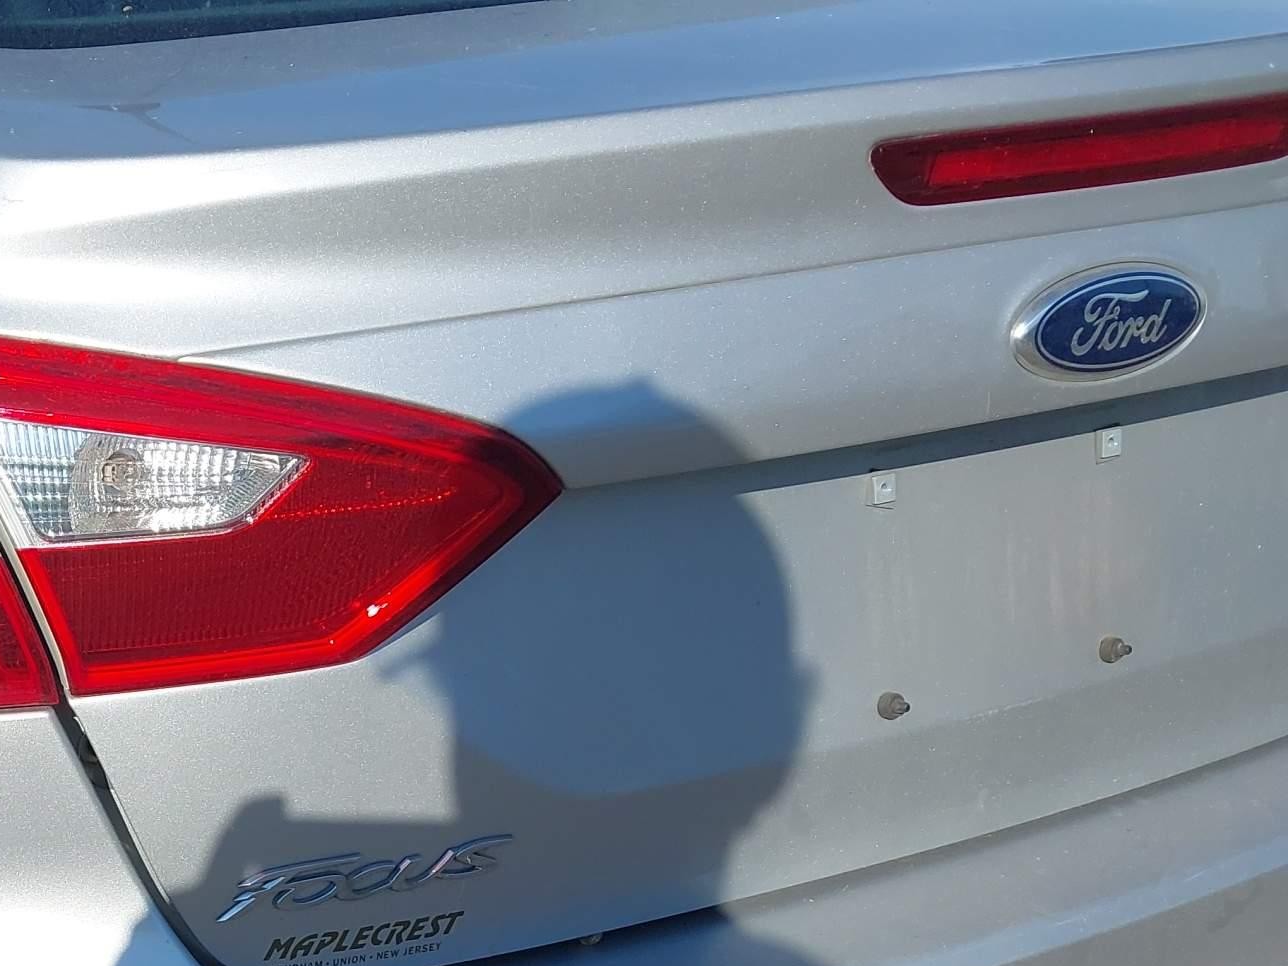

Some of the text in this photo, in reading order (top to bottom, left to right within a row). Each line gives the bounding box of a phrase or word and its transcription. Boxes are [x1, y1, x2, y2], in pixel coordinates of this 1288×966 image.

[1070, 289, 1172, 356] Ford
[264, 911, 464, 961] MAPLECREST
[376, 950, 400, 961] NEW
[402, 941, 443, 957] JERSEY
